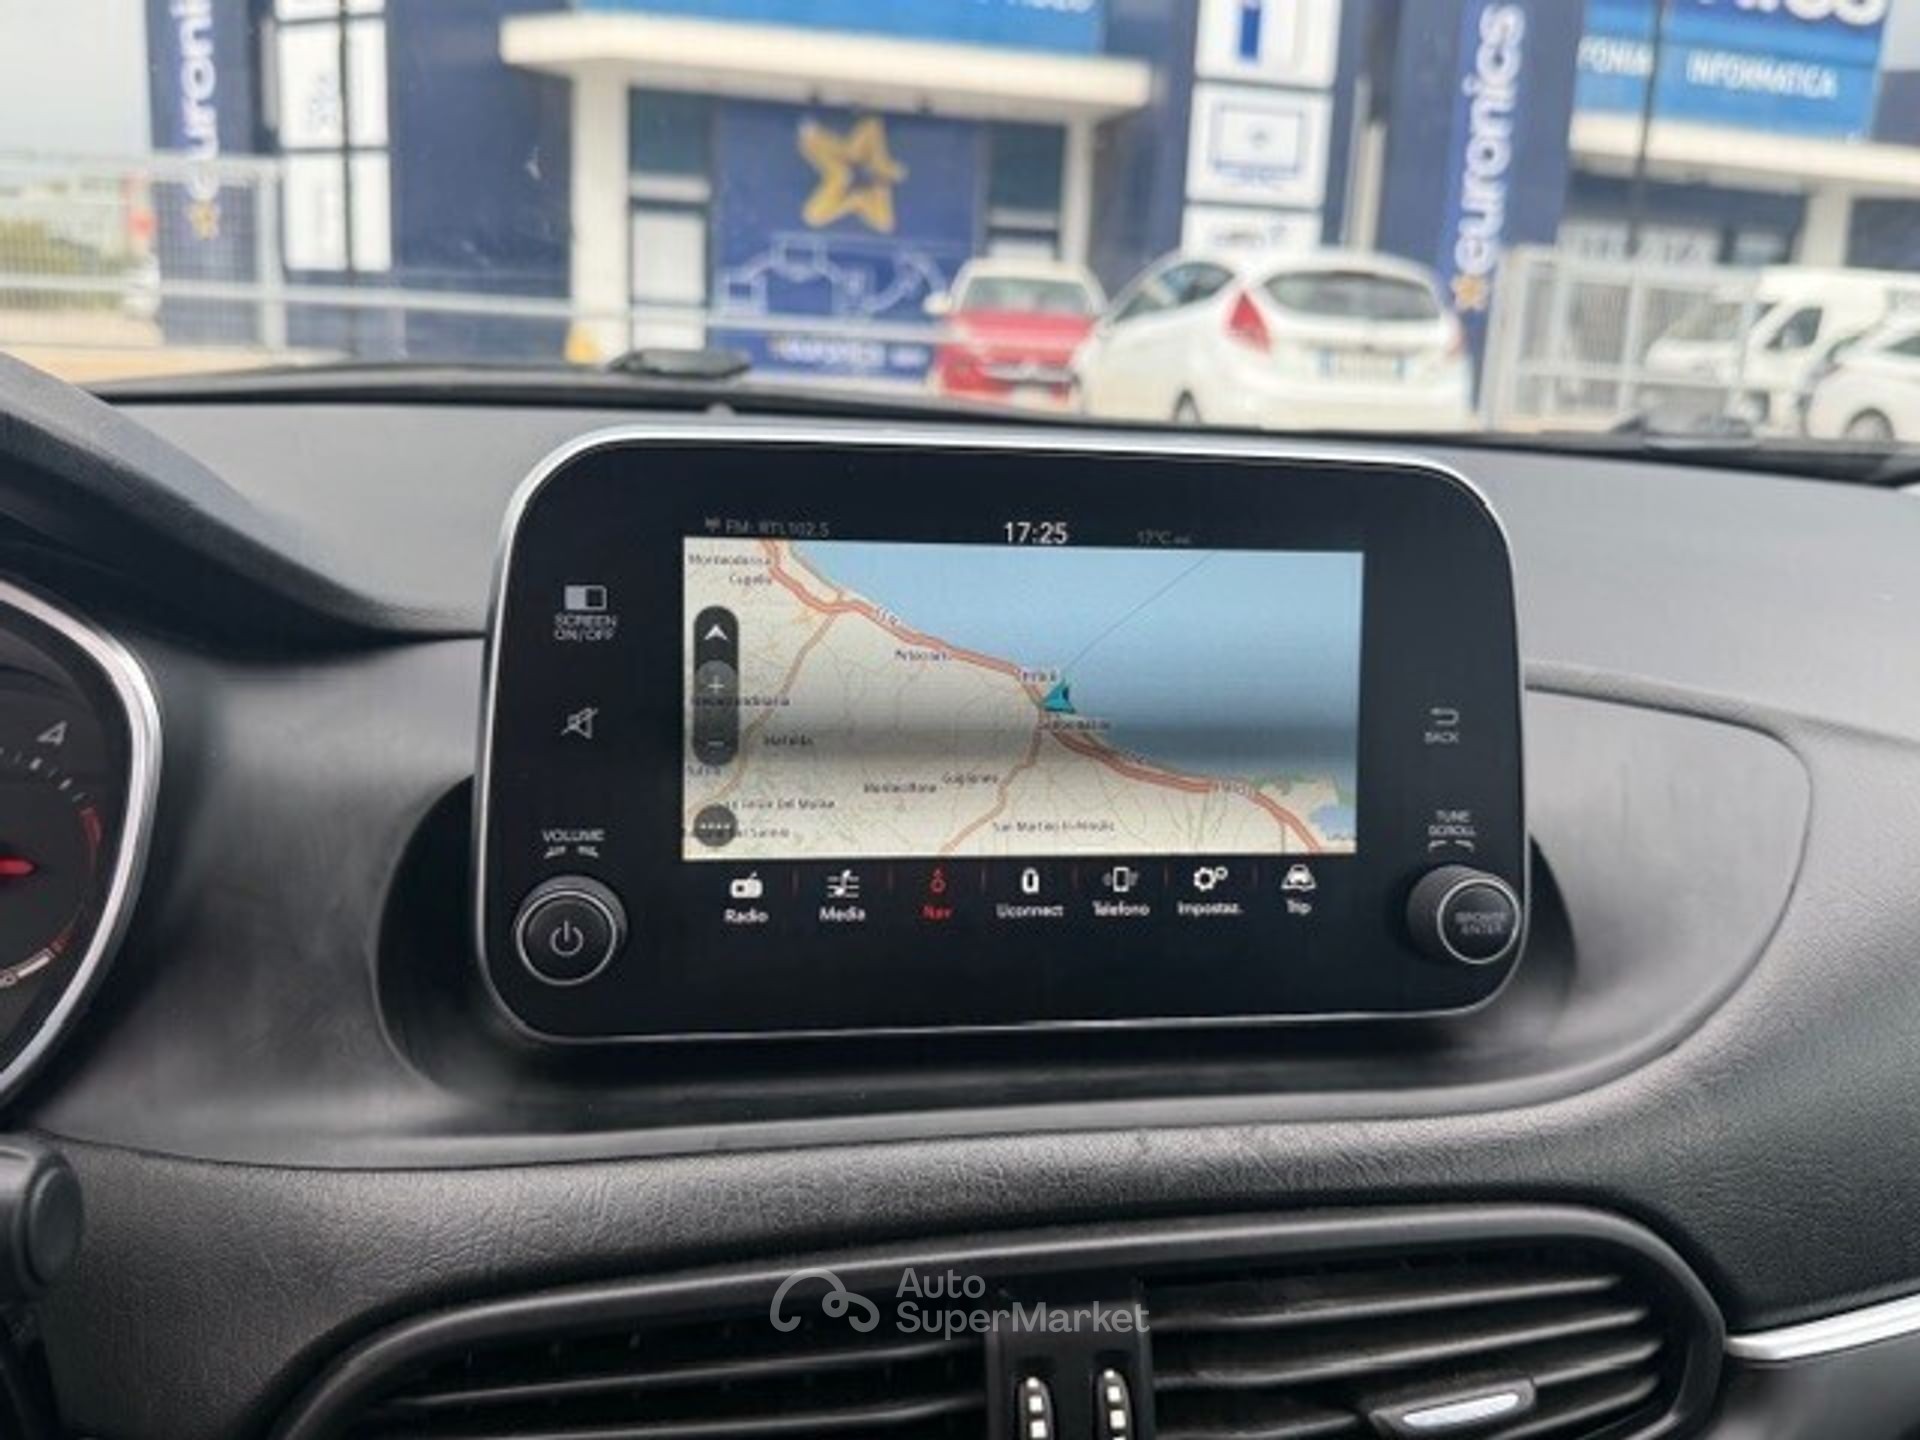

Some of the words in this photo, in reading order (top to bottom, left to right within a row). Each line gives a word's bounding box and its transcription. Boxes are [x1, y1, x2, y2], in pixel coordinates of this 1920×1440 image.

[1686, 49, 1839, 98] INFORMATICA
[1453, 3, 1526, 276] euronics
[1004, 522, 1069, 545] 17:25
[1424, 731, 1460, 744] BACK
[542, 830, 605, 842] VOLUME
[724, 908, 769, 923] Radio
[819, 906, 866, 922] Media
[922, 906, 952, 919] Nav
[997, 903, 1064, 918] Uconnect
[1092, 900, 1150, 916] Telefono
[1286, 900, 1311, 916] Trip
